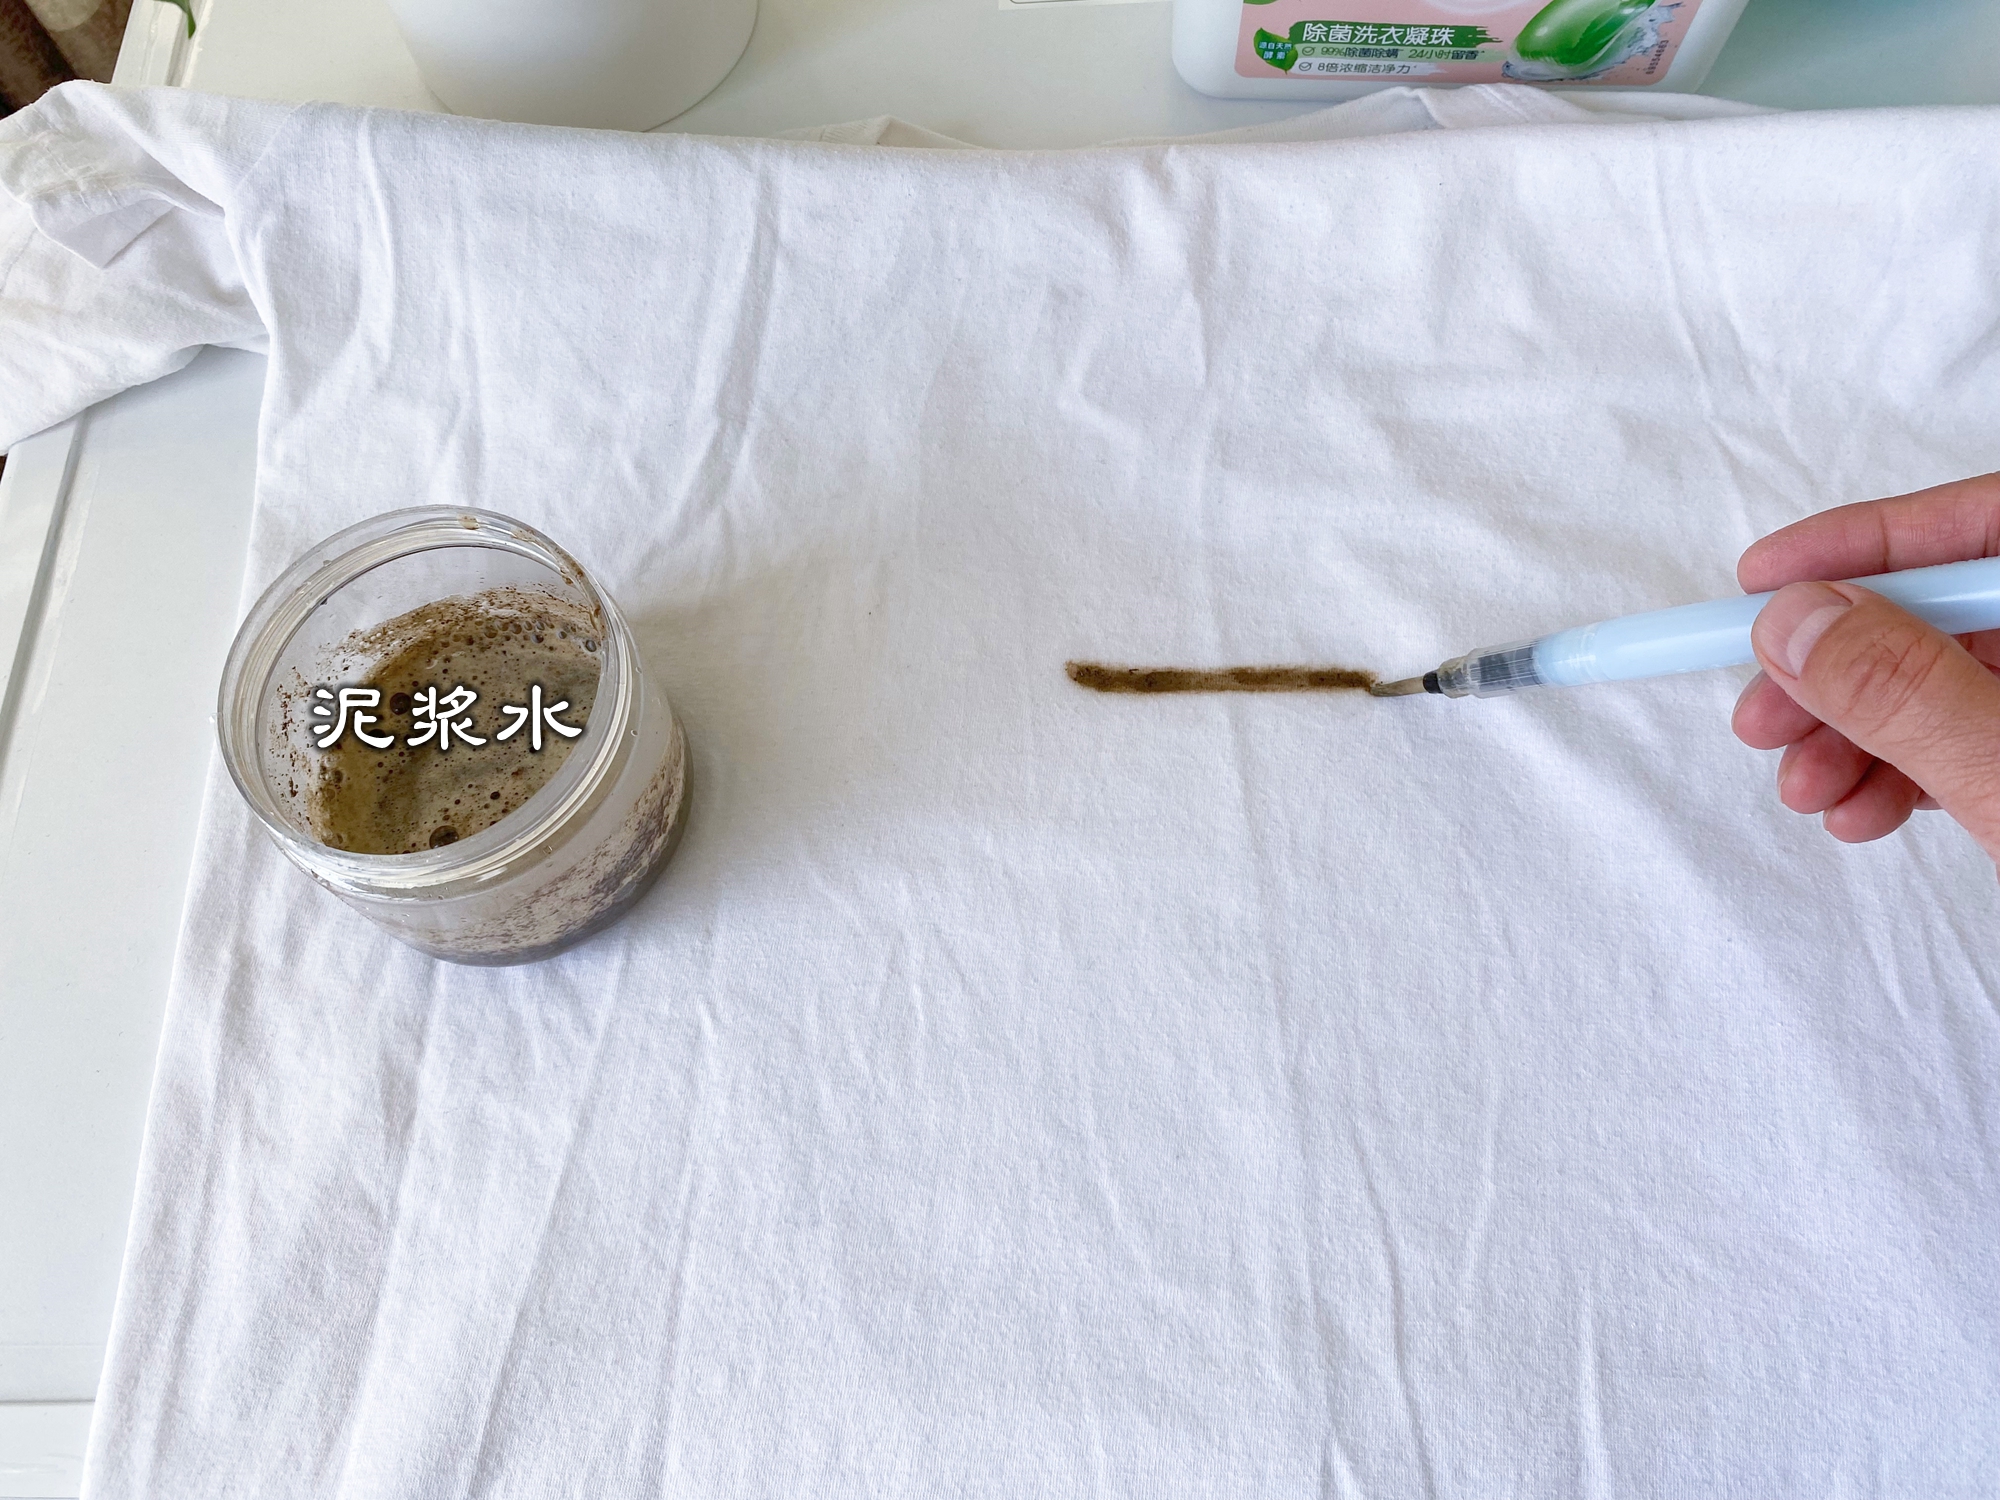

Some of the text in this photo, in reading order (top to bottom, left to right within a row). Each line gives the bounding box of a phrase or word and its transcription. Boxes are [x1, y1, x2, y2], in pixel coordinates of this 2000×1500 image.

[1302, 22, 1456, 46] 除菌洗衣凝珠
[1317, 62, 1411, 75] 8倍浓缩洁净力
